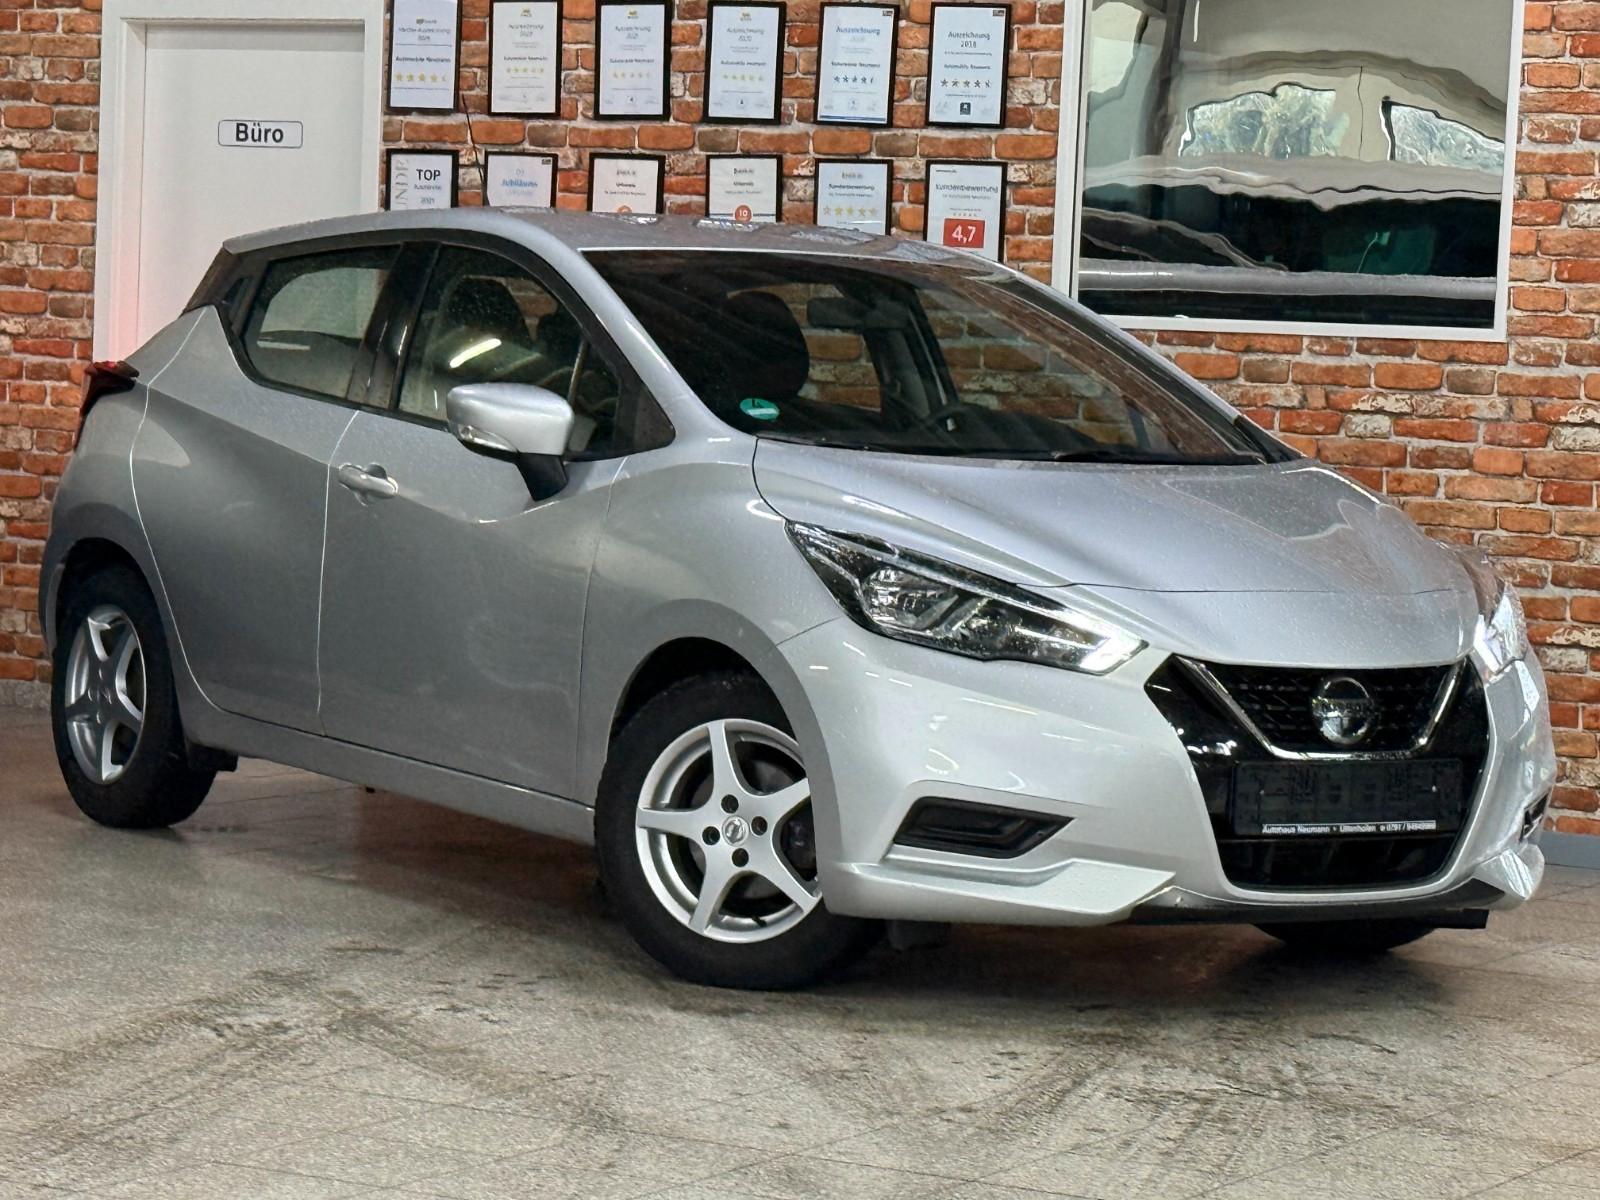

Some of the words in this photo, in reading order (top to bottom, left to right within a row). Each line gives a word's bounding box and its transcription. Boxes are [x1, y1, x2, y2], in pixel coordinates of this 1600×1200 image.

[947, 31, 991, 41] Auszeichnung
[235, 122, 284, 143] Büro
[415, 168, 441, 181] TOP
[951, 224, 977, 244] 4,7
